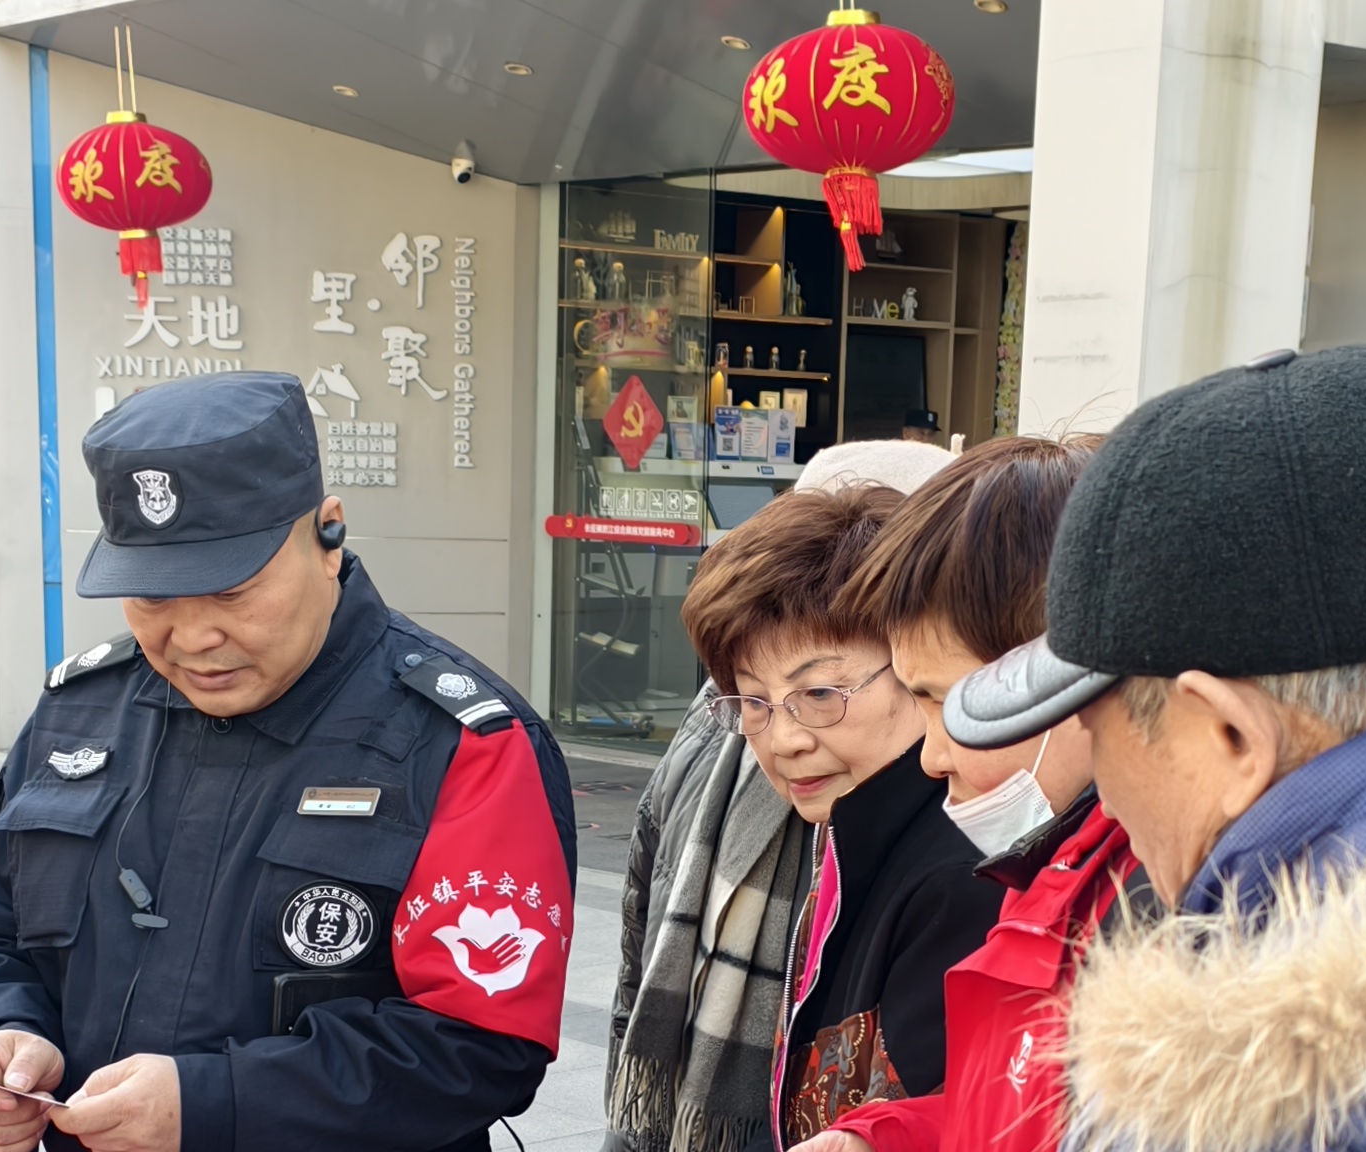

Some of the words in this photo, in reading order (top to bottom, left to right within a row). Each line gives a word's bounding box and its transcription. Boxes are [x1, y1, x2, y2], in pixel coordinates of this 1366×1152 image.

[450, 236, 476, 355] Neighbors
[452, 362, 476, 469] Gathered
[300, 946, 342, 963] BAOAN
[315, 901, 342, 943] 保安
